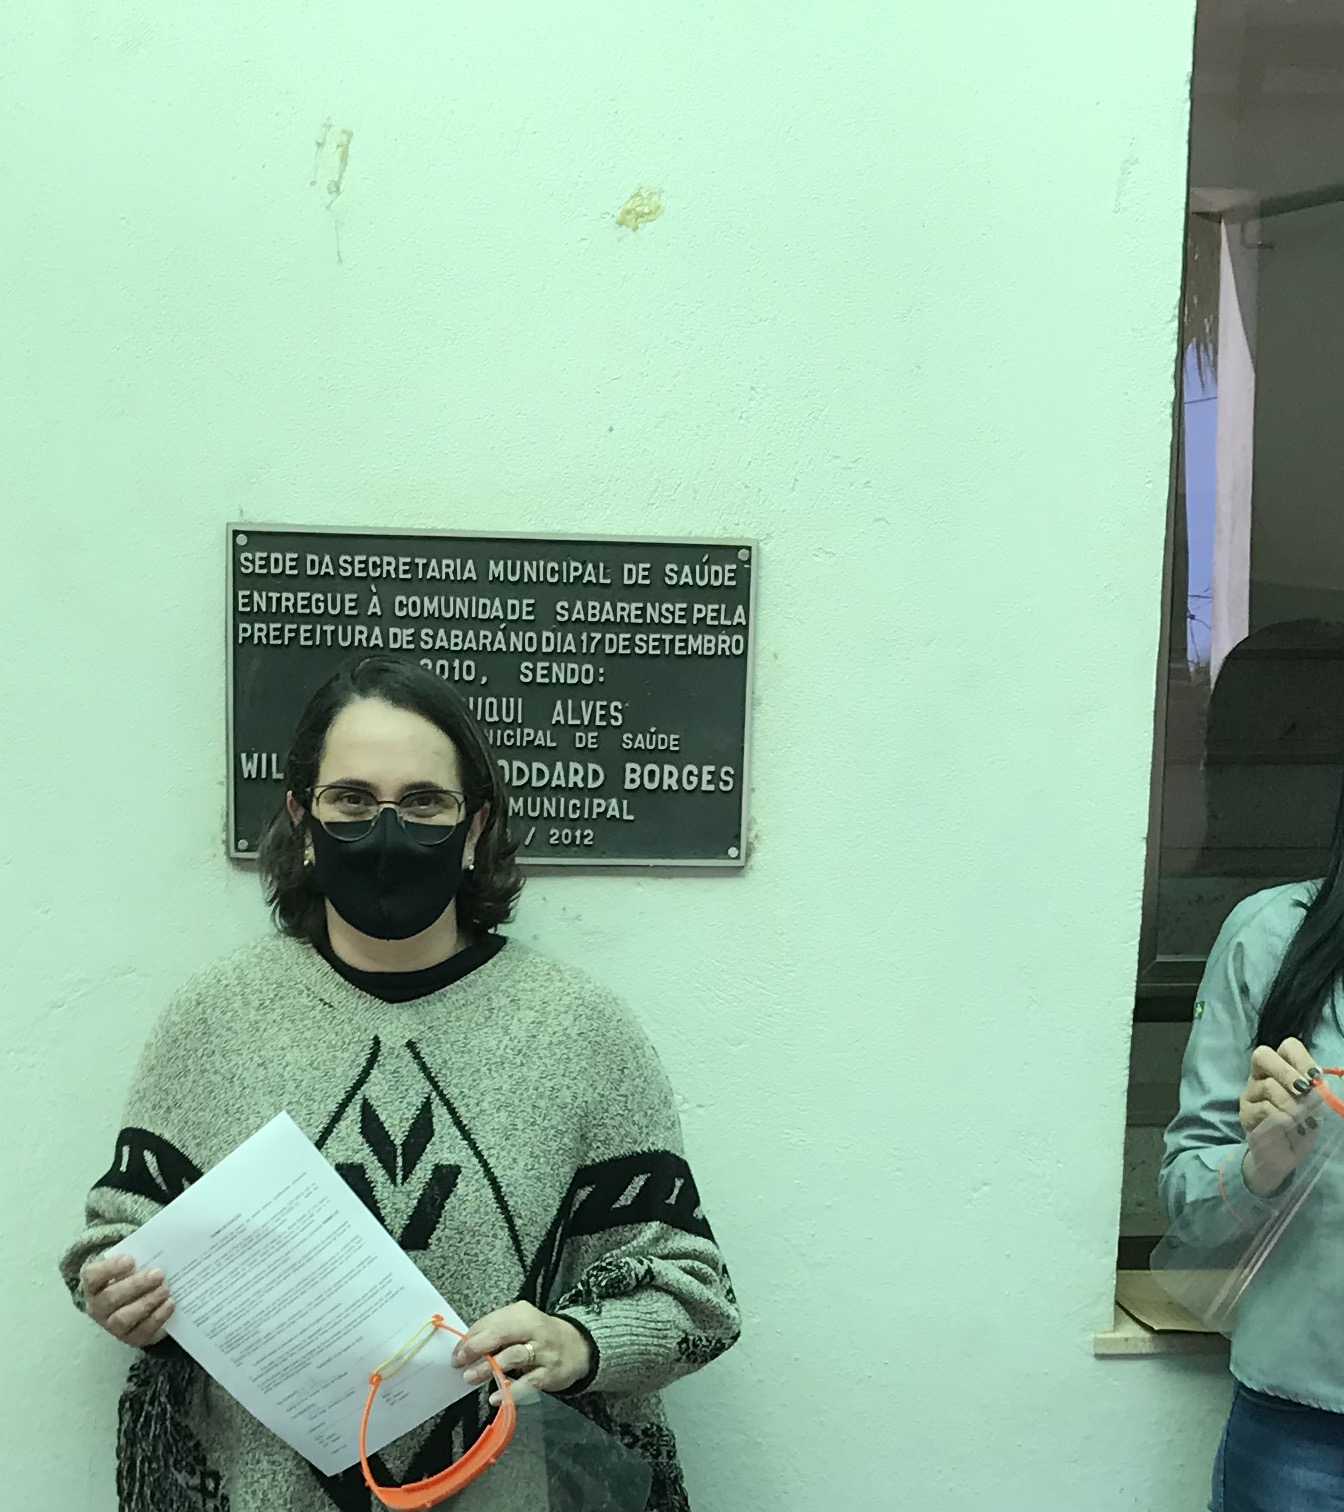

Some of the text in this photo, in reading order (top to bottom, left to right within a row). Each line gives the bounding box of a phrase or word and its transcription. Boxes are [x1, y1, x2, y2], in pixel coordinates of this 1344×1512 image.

[240, 552, 737, 586] SEDE DA SECRETARIA MUNICIPAL DE SAÚDE
[238, 584, 747, 626] ENTREGUE À COMUNIDADE SABARENSE PELA
[238, 622, 745, 656] PREFEITURA DE SABARÁ NO DIA 17 DE SETEMBRO
[519, 661, 605, 685] SENDO:
[469, 696, 623, 727] IQUI ALVES
[484, 727, 680, 751] NICIPAL DE SAÚDE
[240, 752, 735, 792] WIL ODDARD BORGES
[508, 796, 635, 821] MUNICIPAL
[549, 828, 594, 845] 2012
